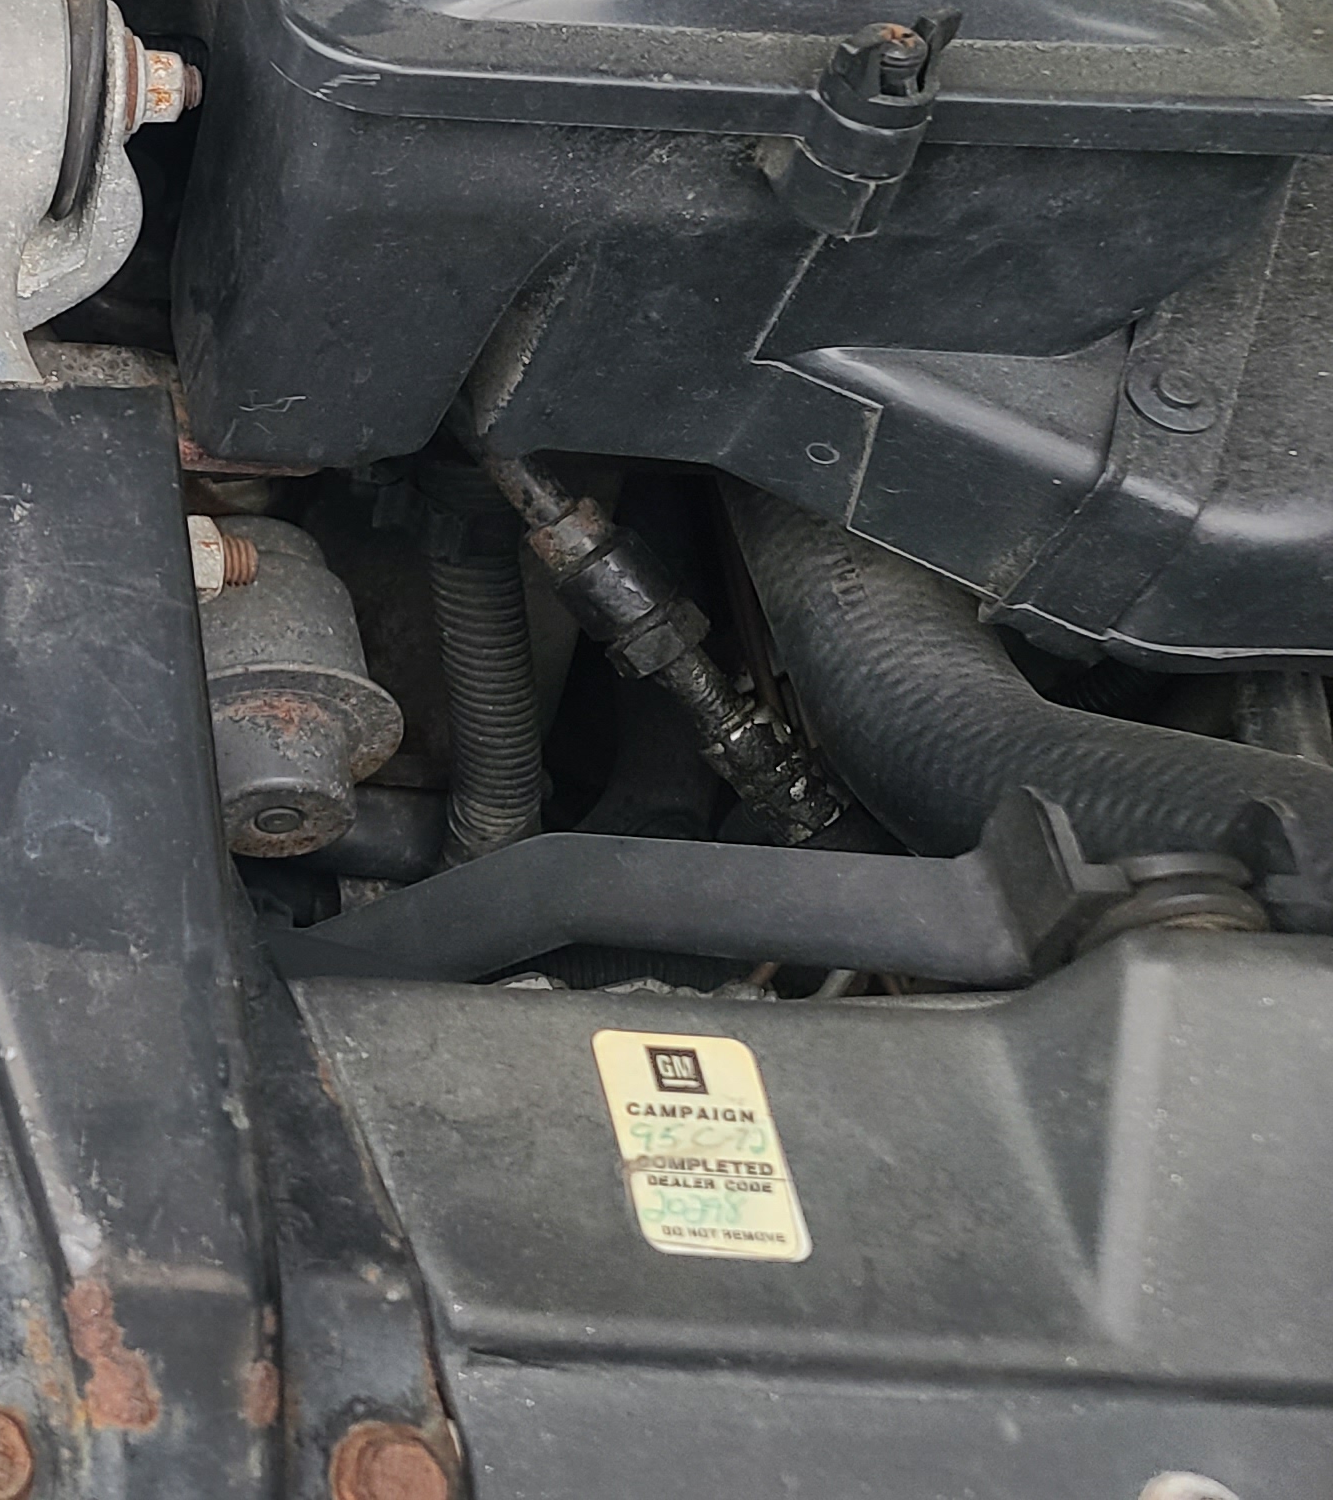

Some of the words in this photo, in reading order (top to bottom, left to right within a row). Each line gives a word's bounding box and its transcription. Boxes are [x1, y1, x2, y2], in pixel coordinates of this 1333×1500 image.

[655, 1054, 695, 1079] GM
[626, 1102, 754, 1123] CAMPAIGN
[636, 1155, 773, 1176] COMPLETED
[648, 1176, 715, 1189] DEALER
[725, 1180, 773, 1192] CODE
[662, 1225, 682, 1236] DO
[688, 1227, 719, 1239] NOT
[723, 1229, 786, 1242] REMOVE
